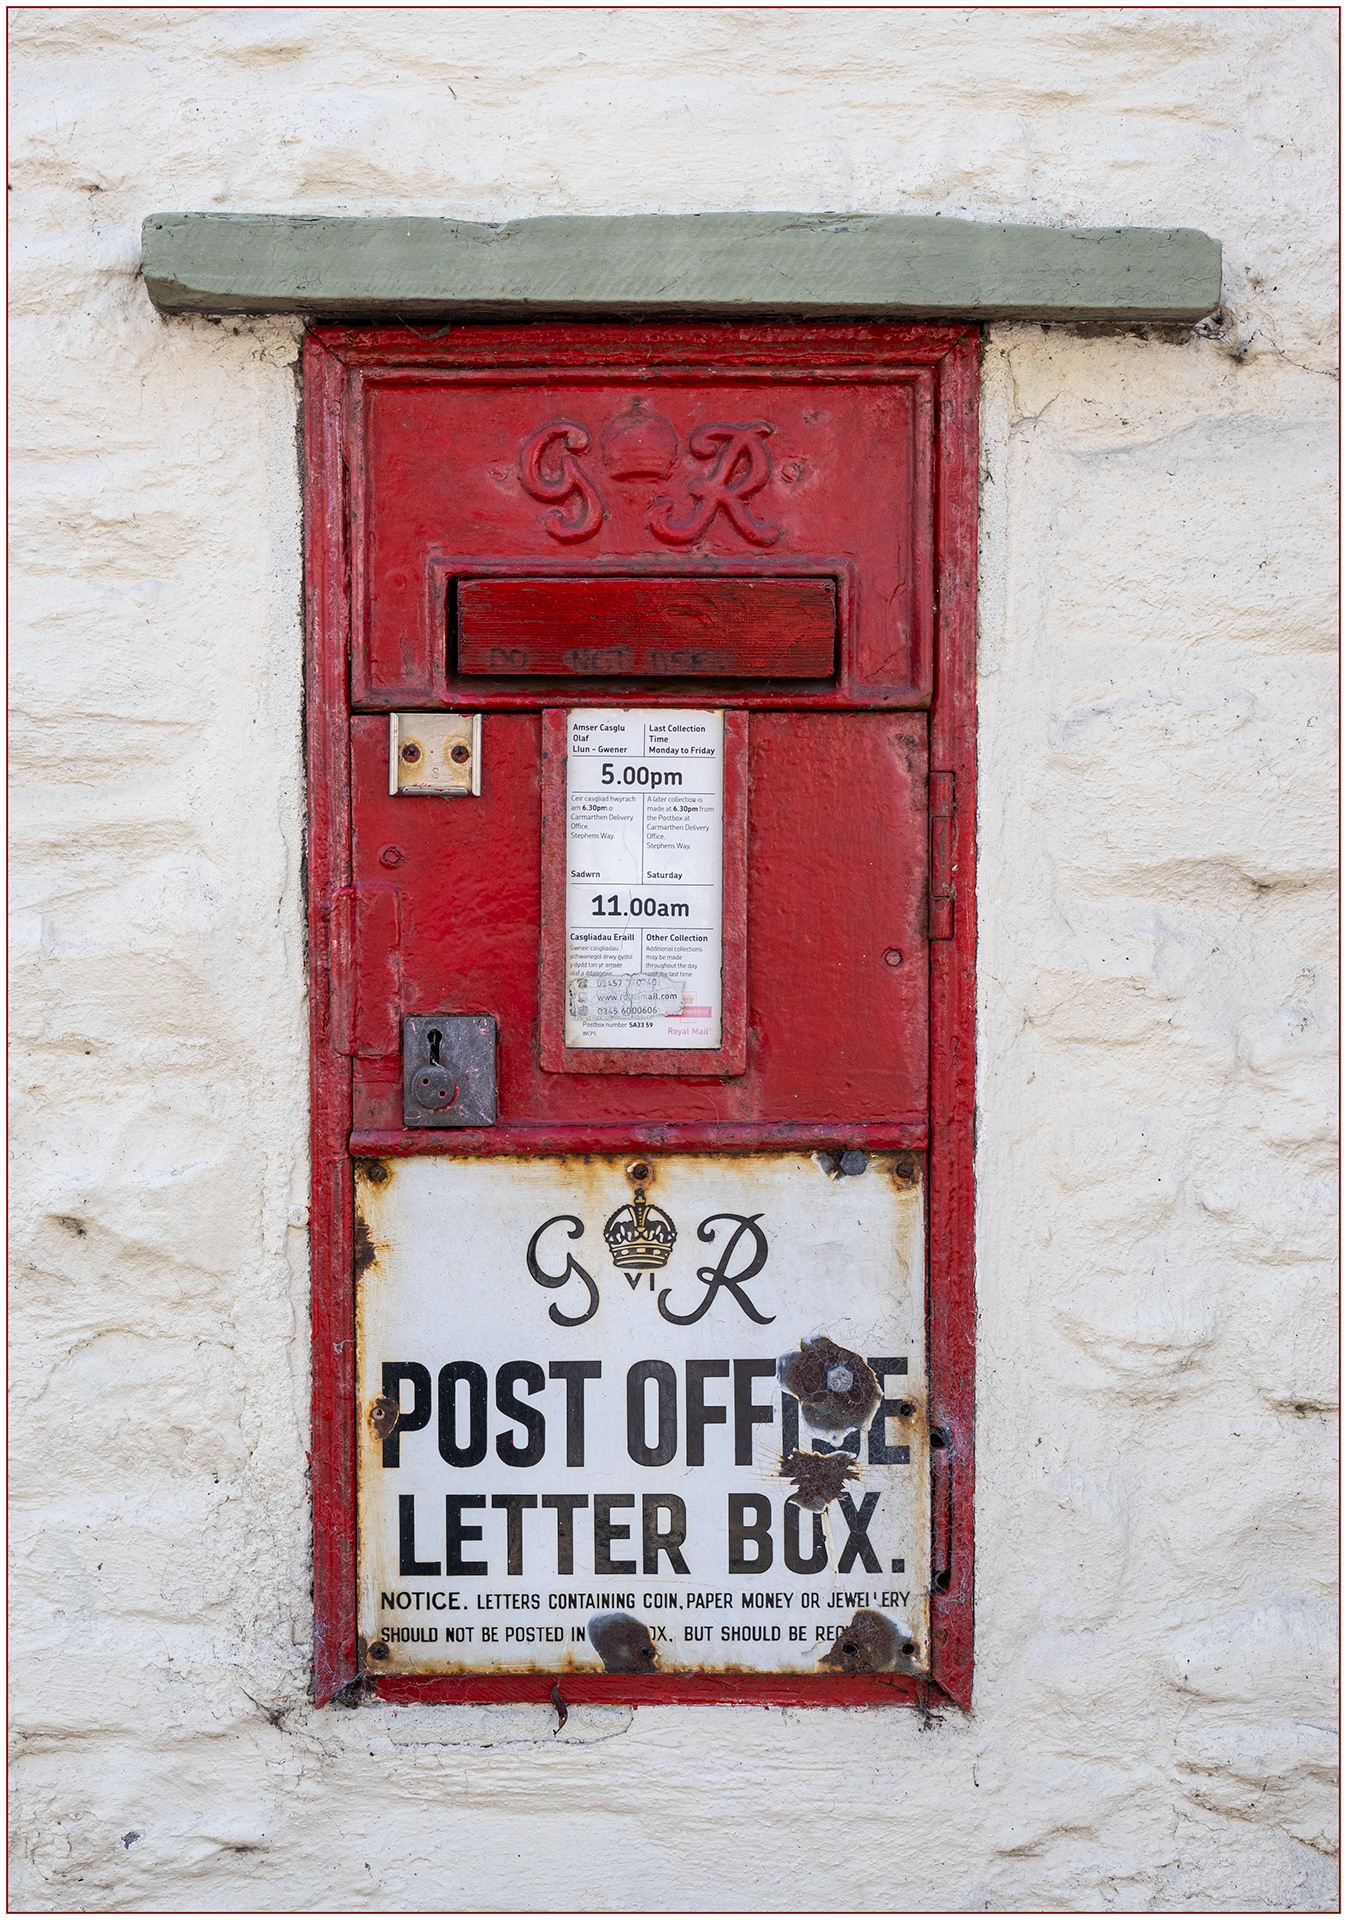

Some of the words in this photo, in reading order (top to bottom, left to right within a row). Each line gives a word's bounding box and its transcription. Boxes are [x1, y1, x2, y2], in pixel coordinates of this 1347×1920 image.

[518, 420, 603, 547] G
[649, 421, 781, 548] R
[573, 724, 598, 732] Amser
[600, 724, 626, 733] Casglu
[649, 725, 666, 733] Last
[667, 725, 706, 733] Collection
[573, 734, 589, 742] Olaf
[649, 735, 669, 743] Time
[573, 745, 590, 753] Llun
[649, 747, 679, 756] Monday
[690, 747, 715, 756] Friday
[601, 763, 683, 790] 5.00pm
[584, 795, 609, 804] casgliad
[610, 795, 636, 804] hwyrach
[608, 814, 634, 823] Delivery
[659, 814, 683, 822] Postbox
[685, 824, 710, 833] Delivery
[571, 832, 600, 840] Stephens
[647, 842, 676, 851] Stephens
[571, 870, 601, 878] Sadwrn
[646, 871, 683, 881] Saturday
[591, 894, 690, 917] 11.00am
[570, 933, 612, 943] Casgliadau
[613, 933, 635, 941] Eraill
[646, 934, 668, 942] Other
[669, 934, 708, 942] Collection
[590, 945, 620, 953] casgliadau
[602, 953, 617, 961] drwy
[621, 1006, 658, 1015] 6000606
[582, 1020, 605, 1028] Postbox
[667, 1027, 690, 1037] Royal
[692, 1027, 709, 1036] Mail
[526, 1214, 600, 1328] G
[657, 1213, 777, 1326] R
[624, 1272, 655, 1291] VI
[382, 1360, 602, 1468] POST
[626, 1356, 911, 1467] OFFIE
[398, 1493, 691, 1577] LETTER
[728, 1491, 905, 1575] BOX.
[381, 1591, 468, 1610] NOTICE.
[477, 1593, 541, 1610] LETTERS
[549, 1592, 636, 1610] CONTAINING
[643, 1592, 684, 1611] COIN,
[686, 1592, 734, 1609] PAPER
[741, 1592, 794, 1609] MONEY
[801, 1592, 821, 1609] OR
[381, 1626, 439, 1643] SHOULD
[446, 1626, 475, 1643] NOT
[481, 1626, 500, 1643] BE
[505, 1626, 565, 1643] POSTED
[571, 1626, 586, 1642] IN
[684, 1625, 714, 1642] BUT
[721, 1625, 781, 1642] SHOULD
[788, 1625, 808, 1642] BE
